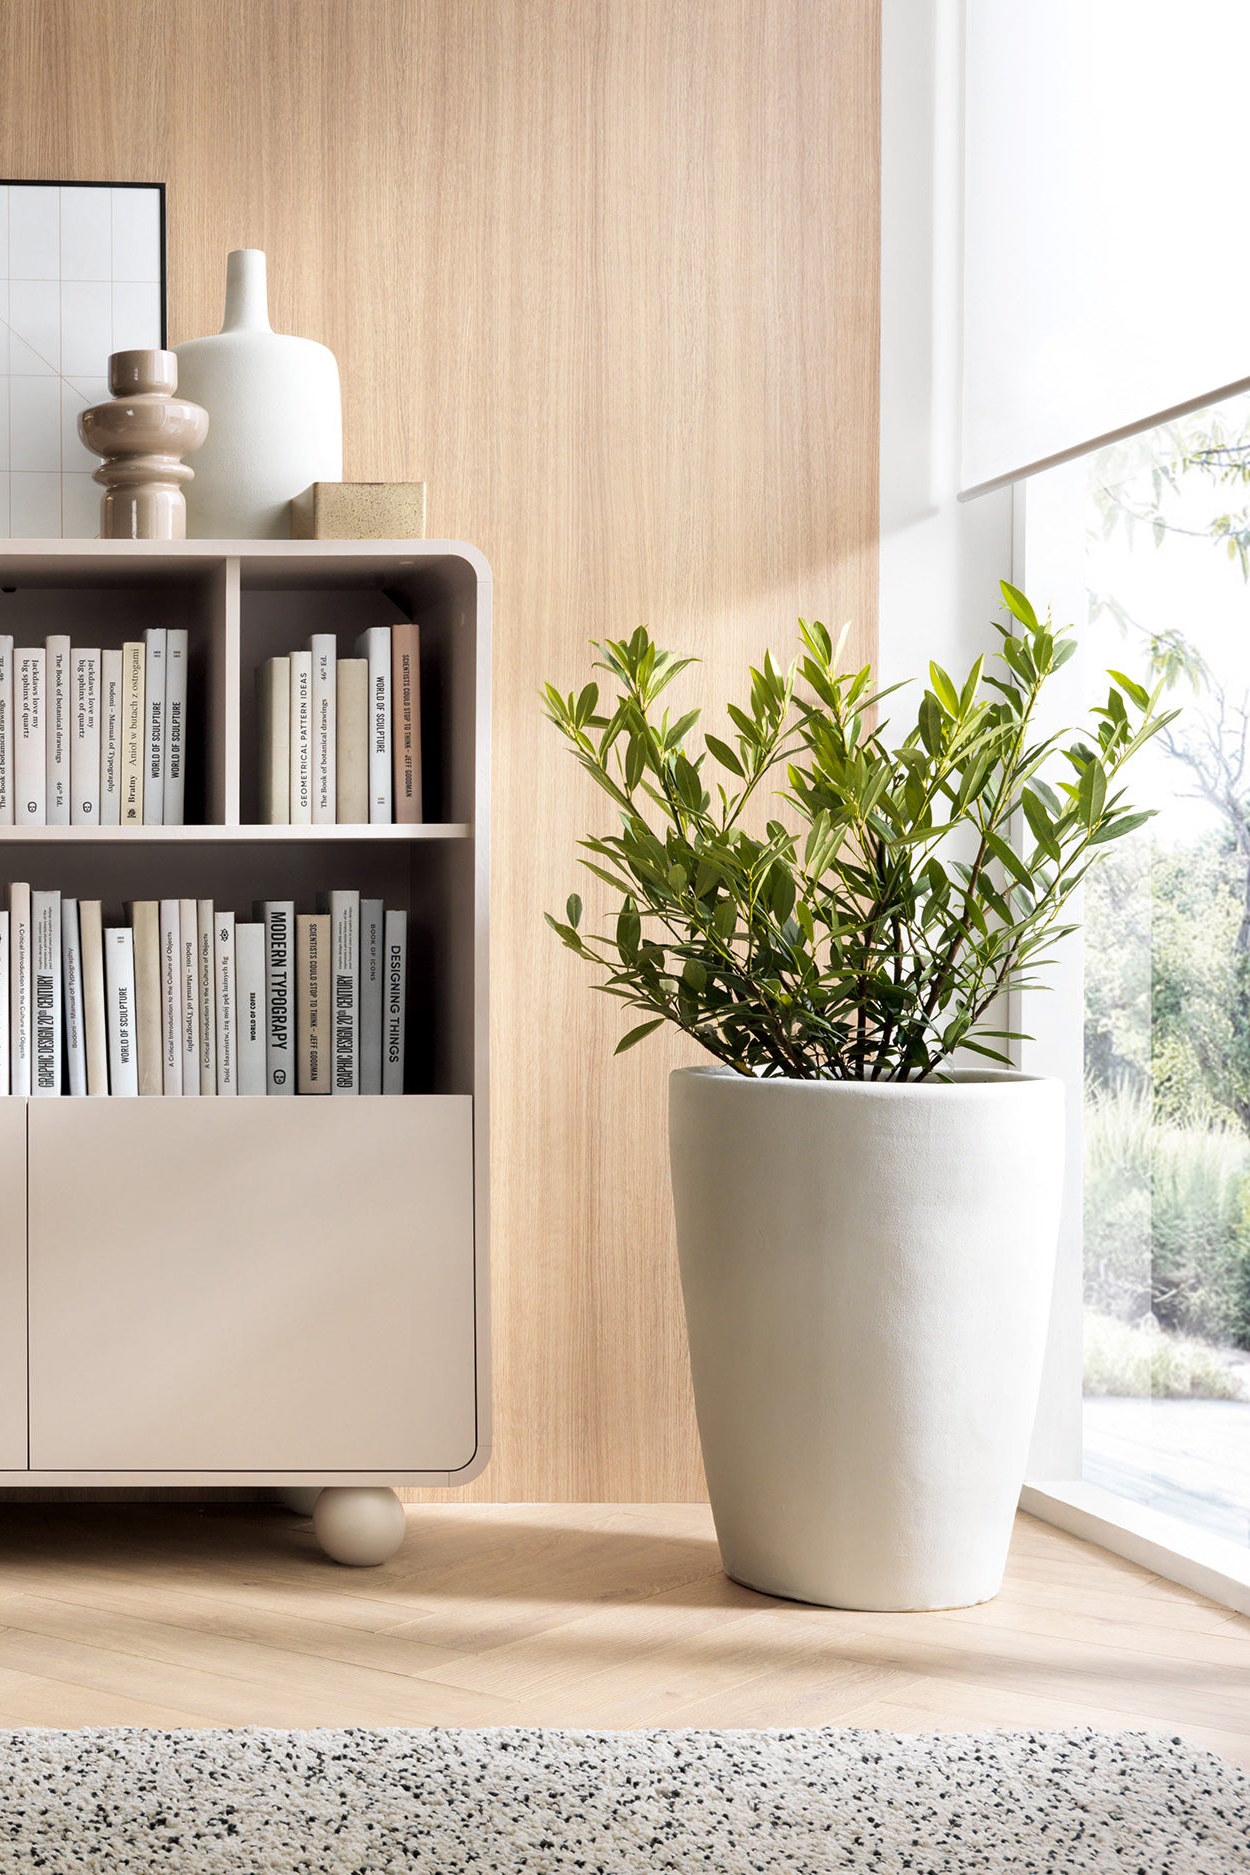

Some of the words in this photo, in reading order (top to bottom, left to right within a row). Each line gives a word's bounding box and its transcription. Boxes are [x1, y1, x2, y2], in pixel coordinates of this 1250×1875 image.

[21, 659, 30, 673] big
[55, 653, 63, 669] The
[77, 659, 86, 673] big
[130, 648, 141, 691] ostrogami
[402, 654, 411, 687] SCIENTISTS
[21, 674, 31, 701] sphinx
[31, 659, 40, 696] Jackdaws
[55, 669, 63, 688] Book
[77, 674, 86, 701] sphinx
[87, 659, 96, 696] Jackdaws
[299, 672, 308, 699] IDEAS
[375, 676, 385, 701] WORLD
[32, 697, 40, 715] love
[56, 688, 63, 697] of
[88, 697, 96, 715] love
[402, 687, 411, 707] COULD
[22, 702, 31, 712] of
[55, 697, 63, 731] botanical
[78, 702, 87, 712] of
[129, 700, 138, 729] butach
[375, 702, 385, 712] OF
[403, 707, 411, 722] STOP
[21, 712, 30, 739] quartz
[31, 716, 38, 729] my
[77, 712, 85, 739] quartz
[86, 716, 94, 729] my
[108, 714, 116, 741] Manual
[151, 701, 162, 742] SCULPTURE
[171, 701, 181, 742] SCULPTURE
[300, 702, 308, 741] PATTERN
[375, 713, 385, 753] SCULPTURE
[403, 723, 412, 731] TO
[54, 731, 63, 764] drawings
[108, 742, 116, 750] of
[151, 743, 161, 753] OF
[171, 743, 181, 753] OF
[404, 732, 412, 749] THINK
[106, 752, 115, 793] Typography
[151, 753, 161, 779] WORLD
[171, 753, 181, 779] WORLD
[404, 754, 413, 768] JEFF
[127, 775, 138, 803] Bratny
[300, 743, 308, 808] GEOMETRICAL
[404, 769, 413, 798] GOODMAN
[270, 912, 287, 967] MODERN
[309, 923, 318, 960] SCIENTISTS
[370, 946, 376, 956] OF
[185, 942, 193, 968] Bodoni
[309, 960, 318, 981] COULD
[389, 945, 401, 1014] DESIGNING
[36, 974, 54, 1009] CENTURY
[186, 974, 194, 1001] Manual
[309, 982, 318, 999] STOP
[336, 974, 354, 1009] CENTURY
[118, 987, 129, 1027] SCULPTURE
[186, 1002, 194, 1010] of
[270, 972, 288, 1050] TYPOGRAPY
[309, 999, 318, 1008] TO
[185, 1011, 195, 1053] Typography
[309, 1009, 318, 1028] THINK
[37, 1026, 55, 1054] DESIGN
[119, 1028, 129, 1038] OF
[309, 1034, 318, 1049] JEFF
[336, 1026, 354, 1054] DESIGN
[388, 1017, 400, 1063] THINGS
[120, 1039, 130, 1064] WORLD
[37, 1054, 55, 1088] GRAPHIC
[309, 1050, 318, 1081] GOODMAN
[336, 1054, 354, 1088] GRAPHIC
